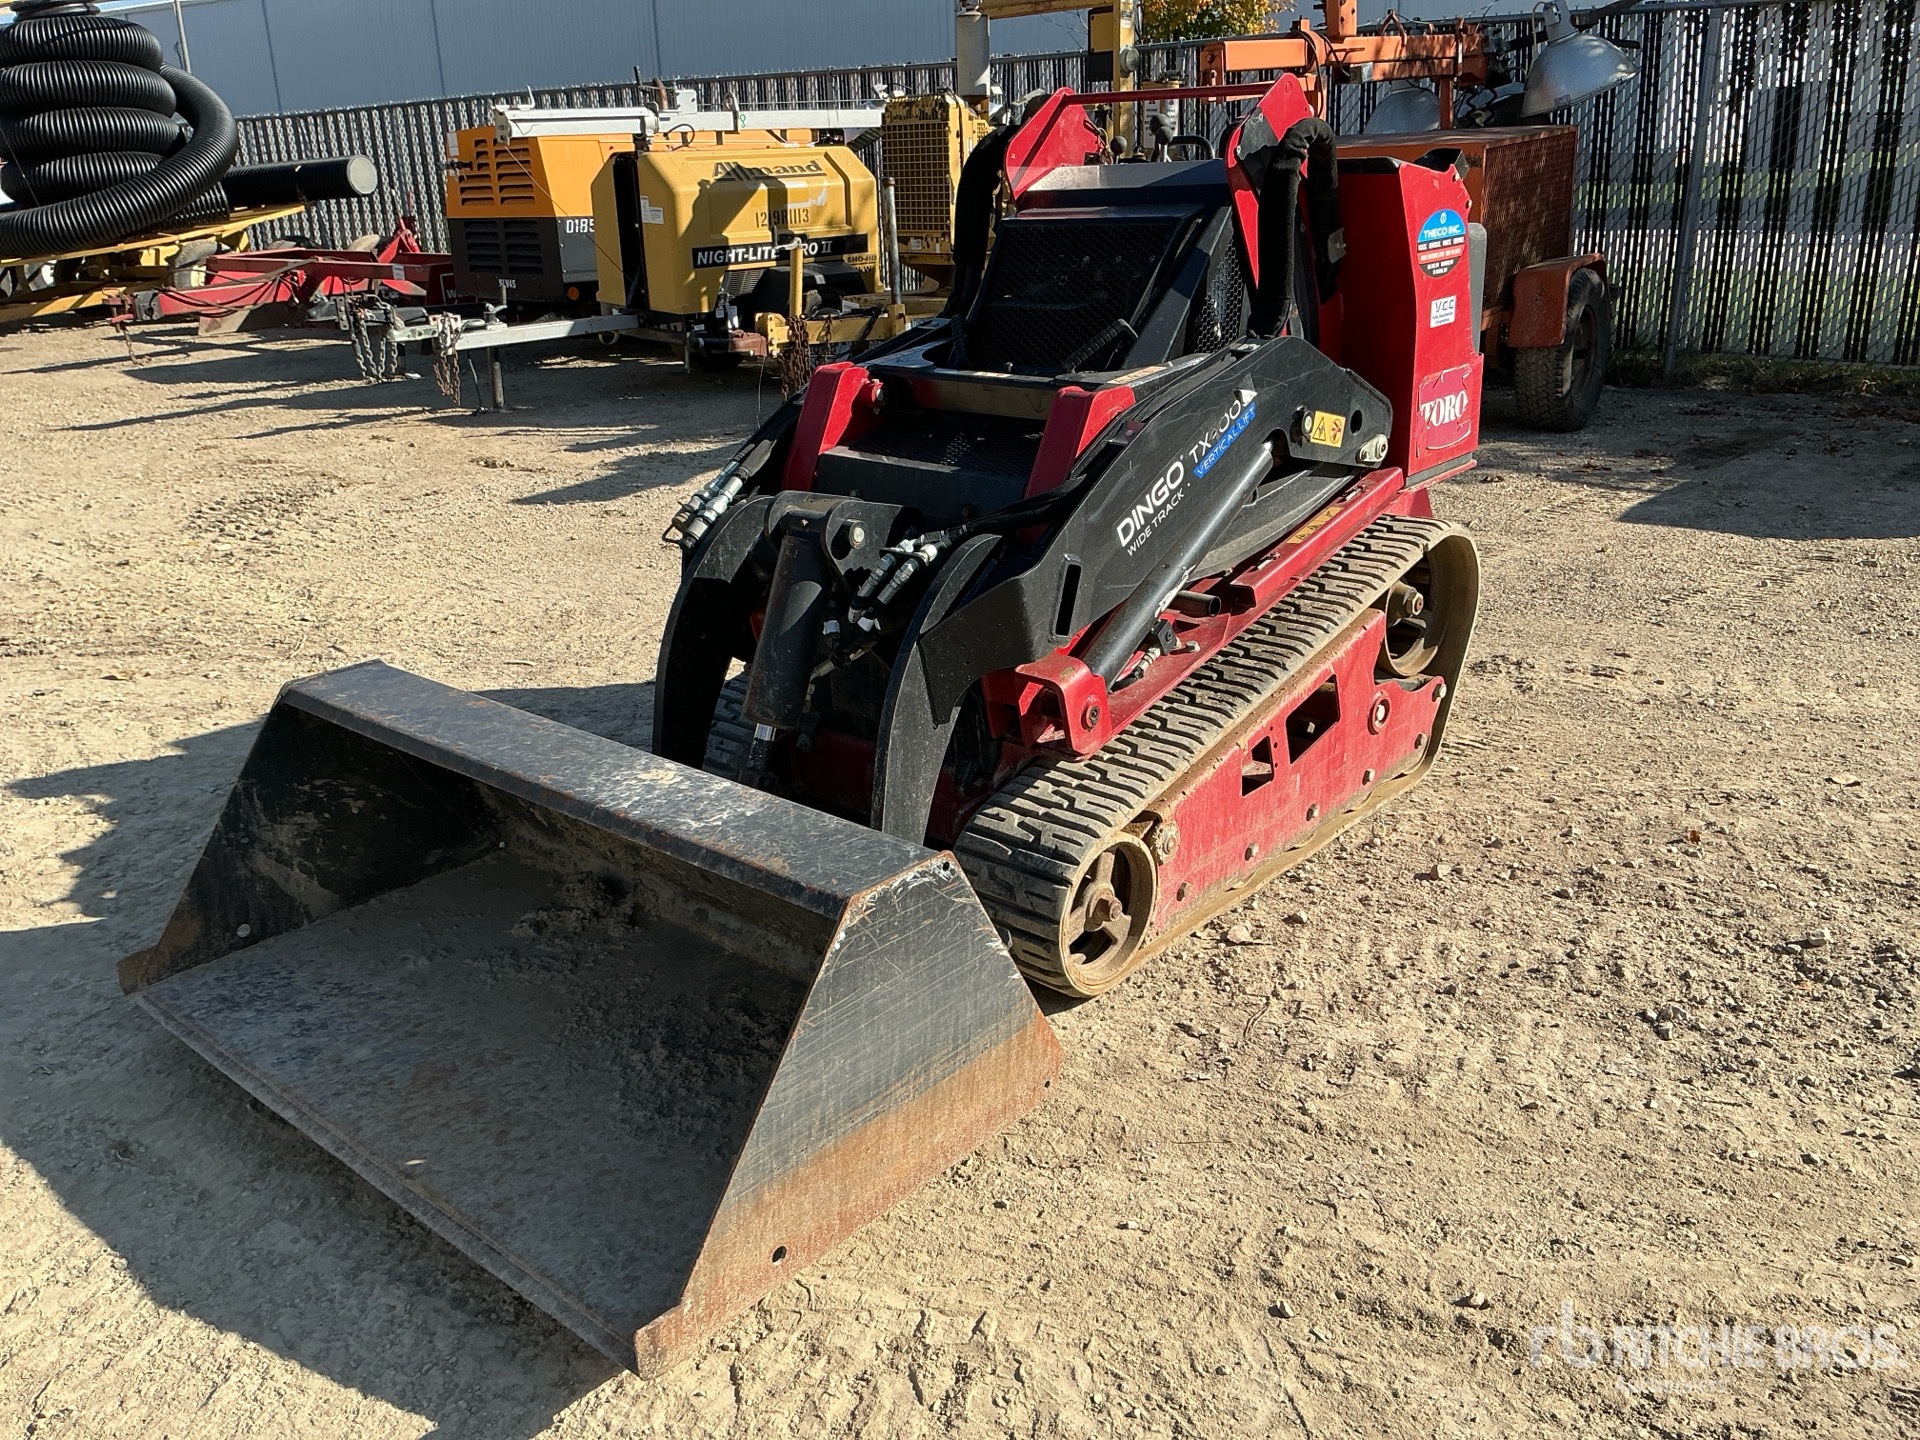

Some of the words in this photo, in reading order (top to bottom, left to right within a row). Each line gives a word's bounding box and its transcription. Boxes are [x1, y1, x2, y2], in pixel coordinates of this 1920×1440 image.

[712, 160, 826, 181] Allmand
[1423, 226, 1448, 239] THECO
[1420, 390, 1469, 427] TORO
[1127, 525, 1152, 556] WIDE
[1151, 488, 1184, 528] TRACK
[1196, 428, 1238, 475] VERTICAL
[1238, 406, 1255, 430] LIFT
[1116, 461, 1184, 547] DINGO
